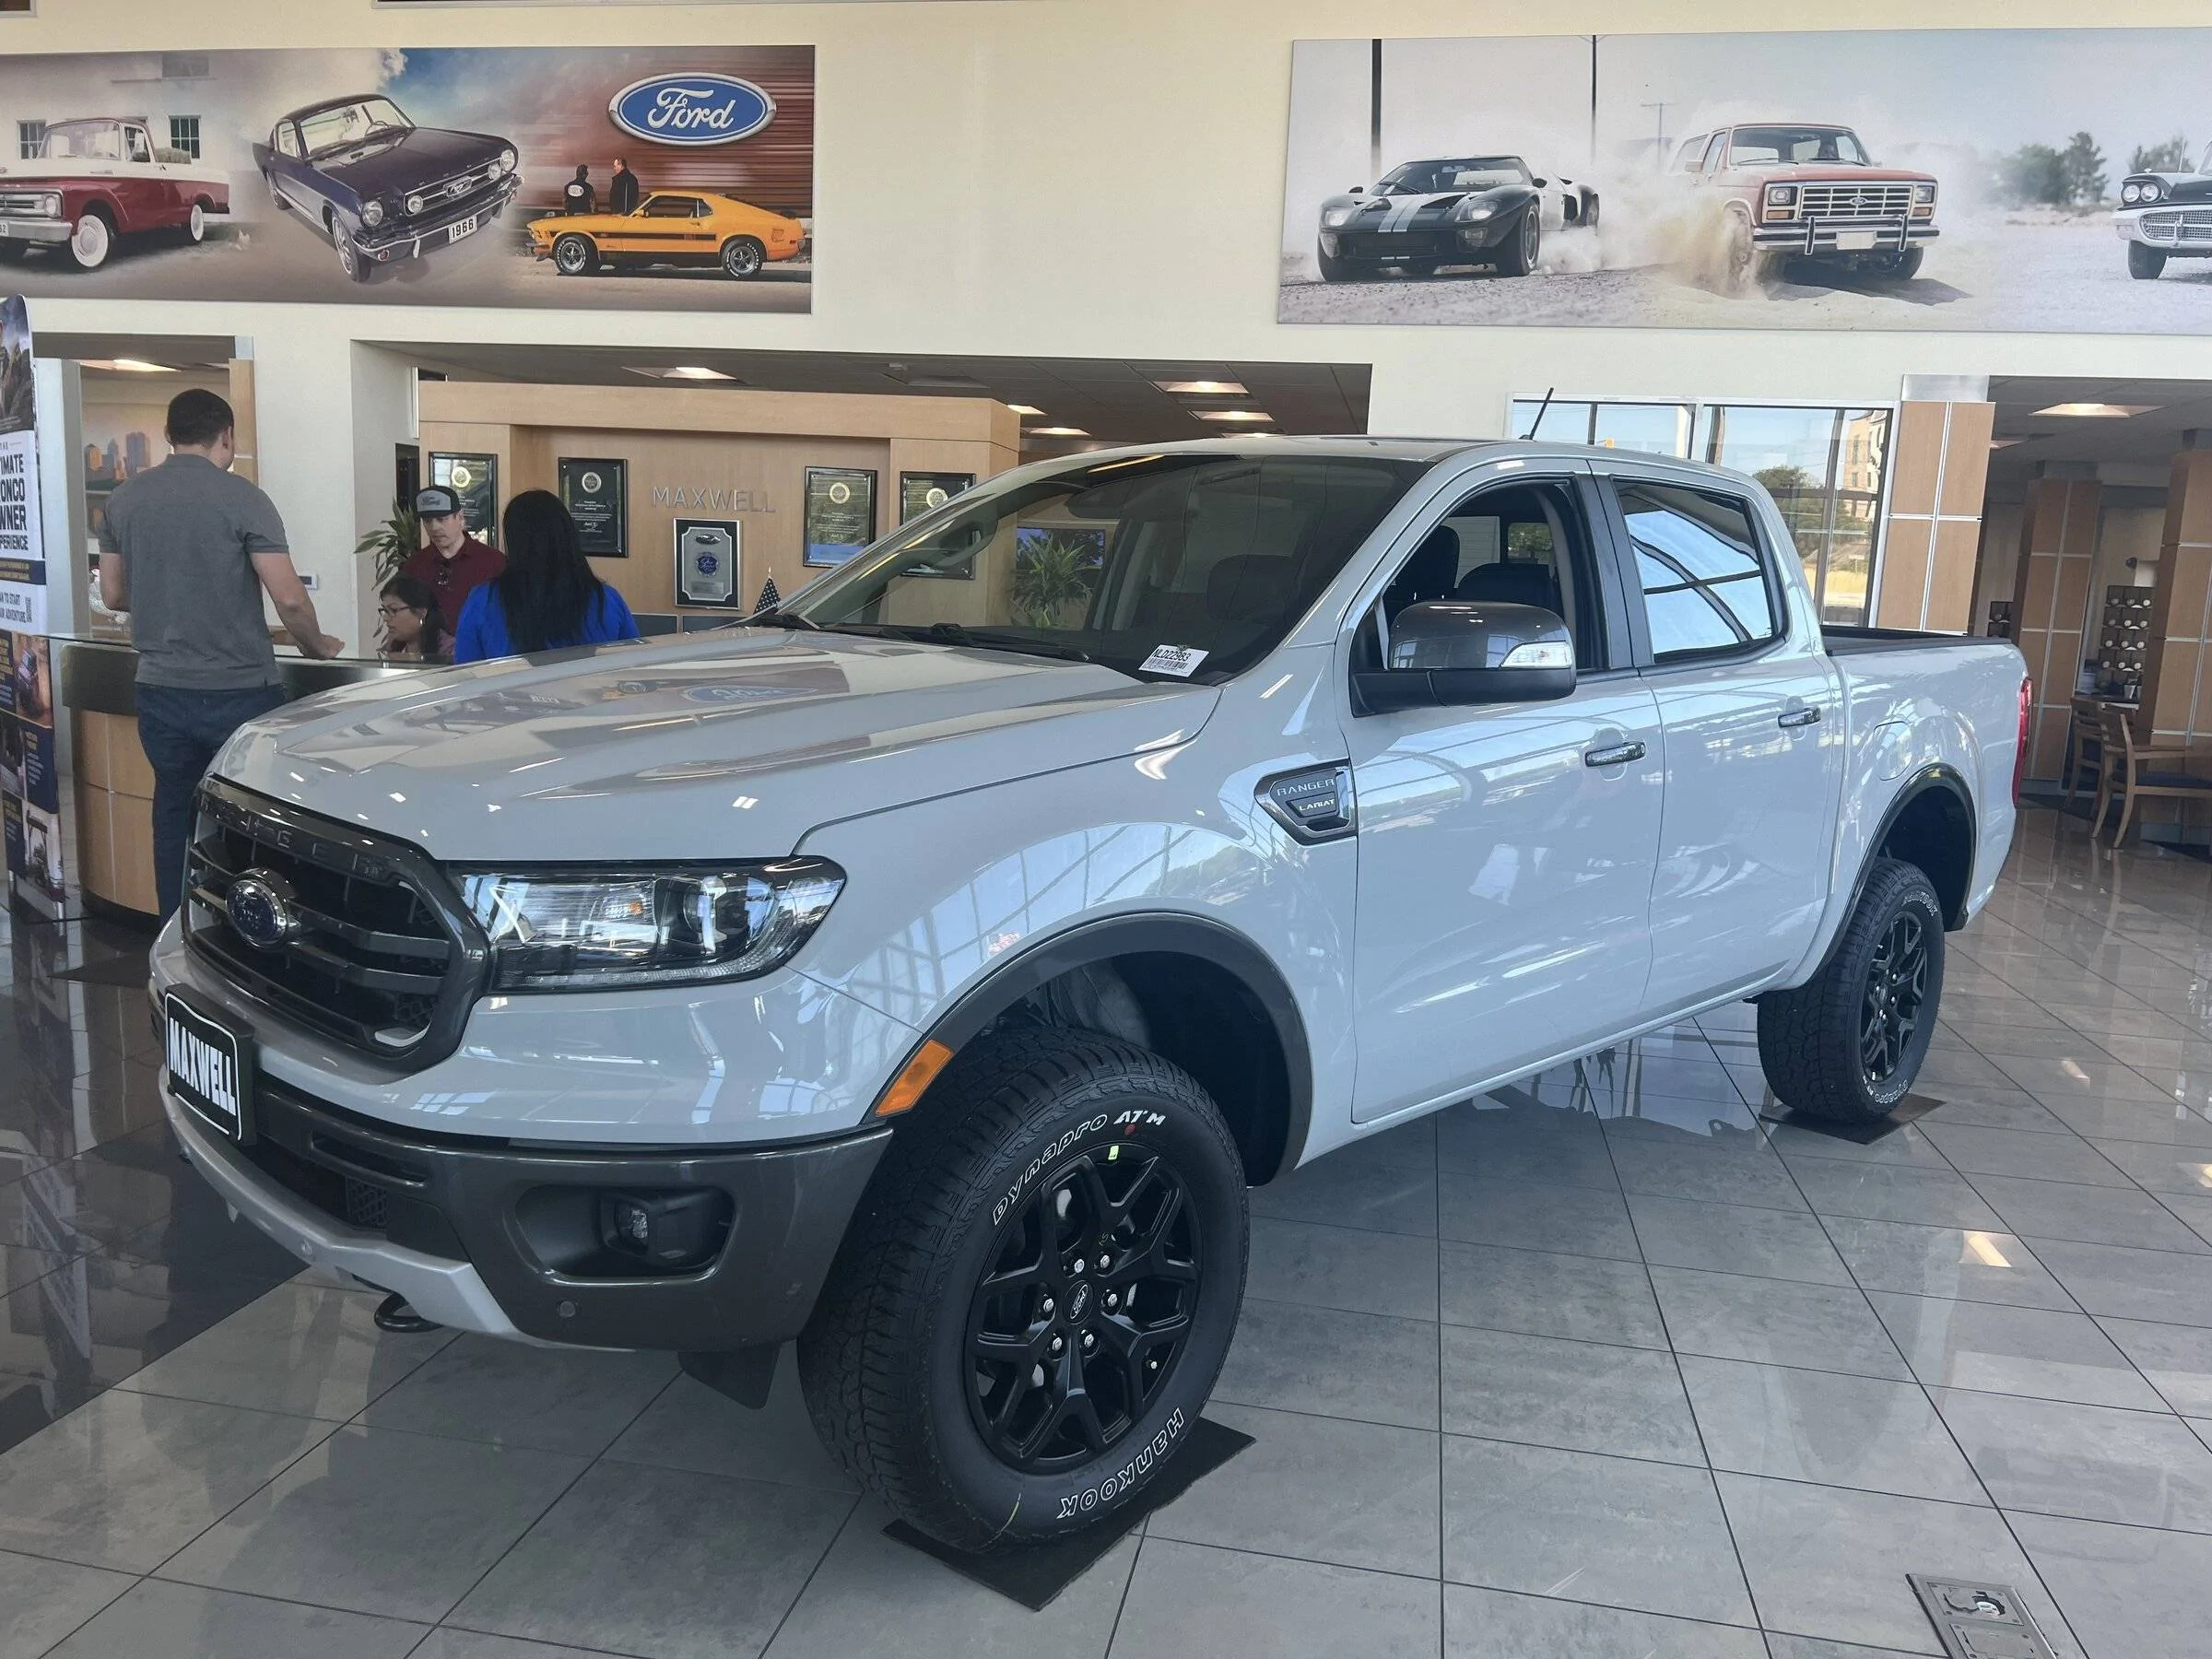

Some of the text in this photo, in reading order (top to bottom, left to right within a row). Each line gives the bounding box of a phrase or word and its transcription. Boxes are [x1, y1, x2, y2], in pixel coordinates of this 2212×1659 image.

[647, 88, 736, 128] Ford
[452, 218, 474, 239] 1966
[653, 486, 776, 513] MAXWELL
[1277, 778, 1335, 796] RANGER
[1299, 798, 1335, 811] LARIAT
[170, 1017, 236, 1116] MAXWELL
